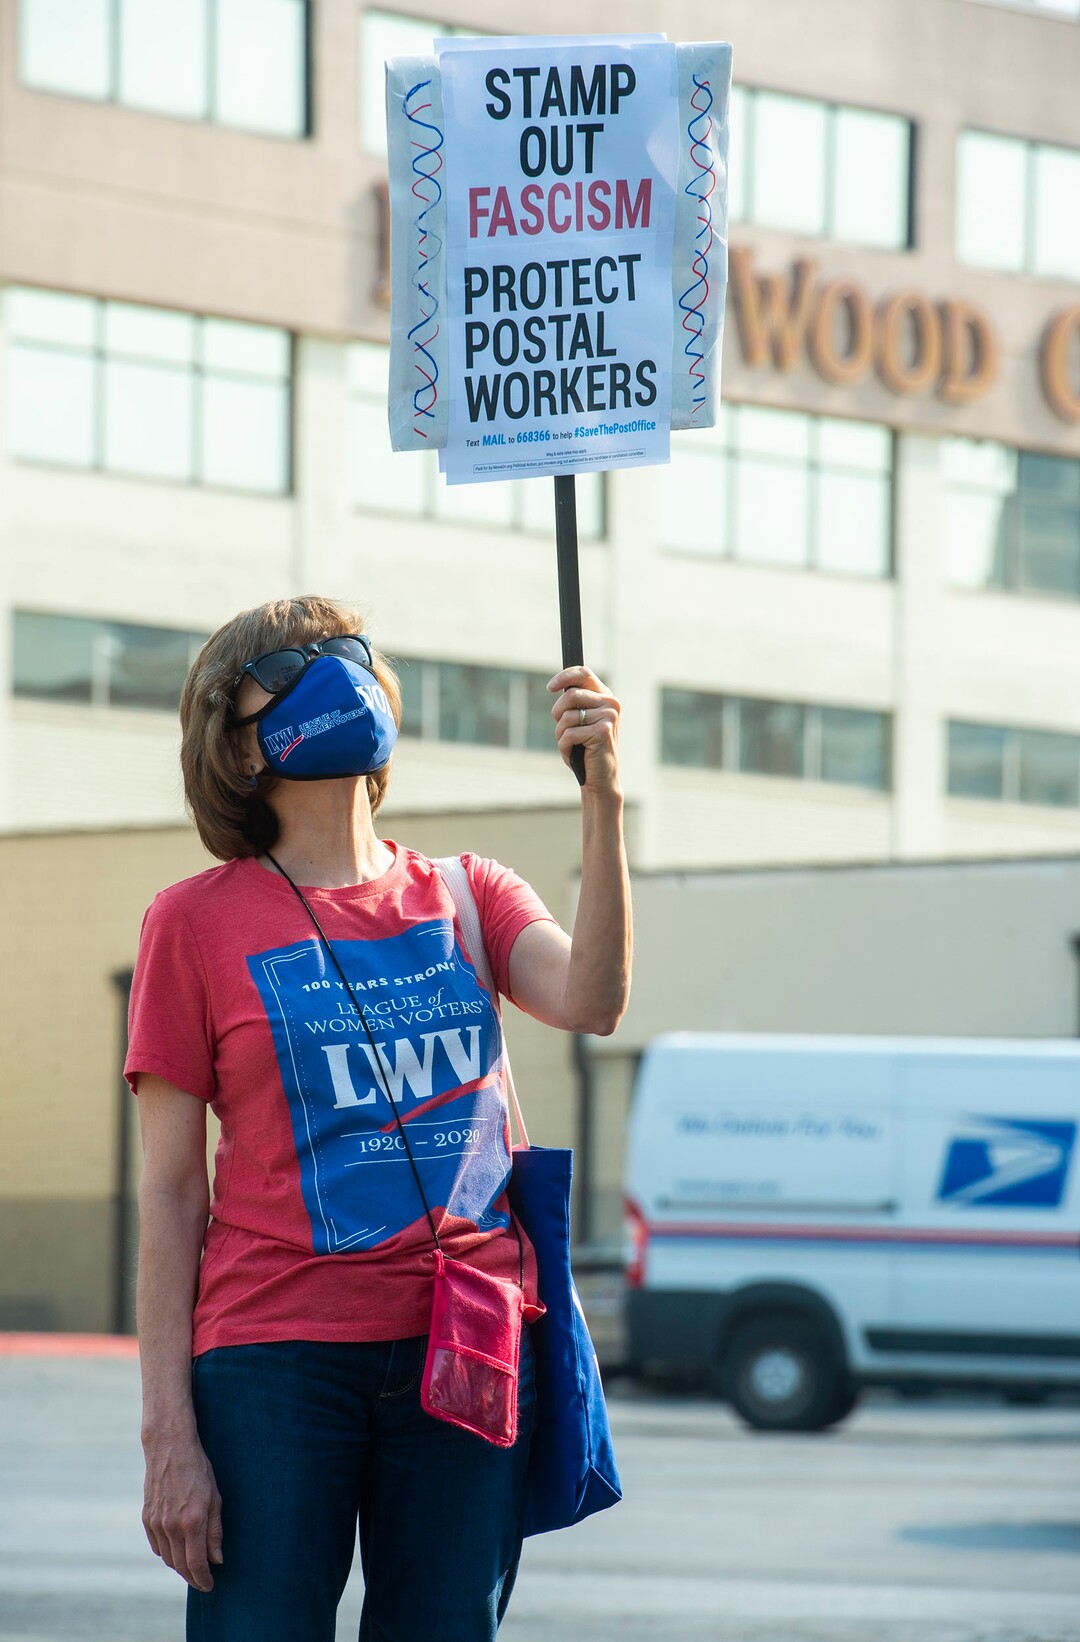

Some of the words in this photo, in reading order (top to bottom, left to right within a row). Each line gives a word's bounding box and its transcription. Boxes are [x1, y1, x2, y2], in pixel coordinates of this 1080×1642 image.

[485, 64, 636, 120] STAMP
[519, 123, 604, 178] OUT
[469, 178, 652, 239] FASCISM
[464, 254, 641, 315] PROTECT
[465, 311, 617, 369] POSTAL
[464, 360, 657, 423] WORKERS
[466, 439, 480, 447] Text
[482, 433, 506, 446] MAIL
[508, 436, 515, 444] to
[516, 430, 550, 443] 668366
[560, 431, 573, 440] help
[574, 419, 656, 438] #SaveThePostOffice
[298, 713, 330, 732] LEAGUE
[302, 721, 335, 739] WOMEN
[263, 726, 295, 755] LWV
[301, 979, 331, 993] 100
[334, 977, 389, 991] YEARS
[336, 996, 422, 1016] LEAGUE
[428, 987, 445, 1007] of
[305, 1017, 395, 1035] WOMEN
[321, 1025, 482, 1110] LWV
[360, 1135, 407, 1153] 1920
[433, 1128, 480, 1147] 2020
